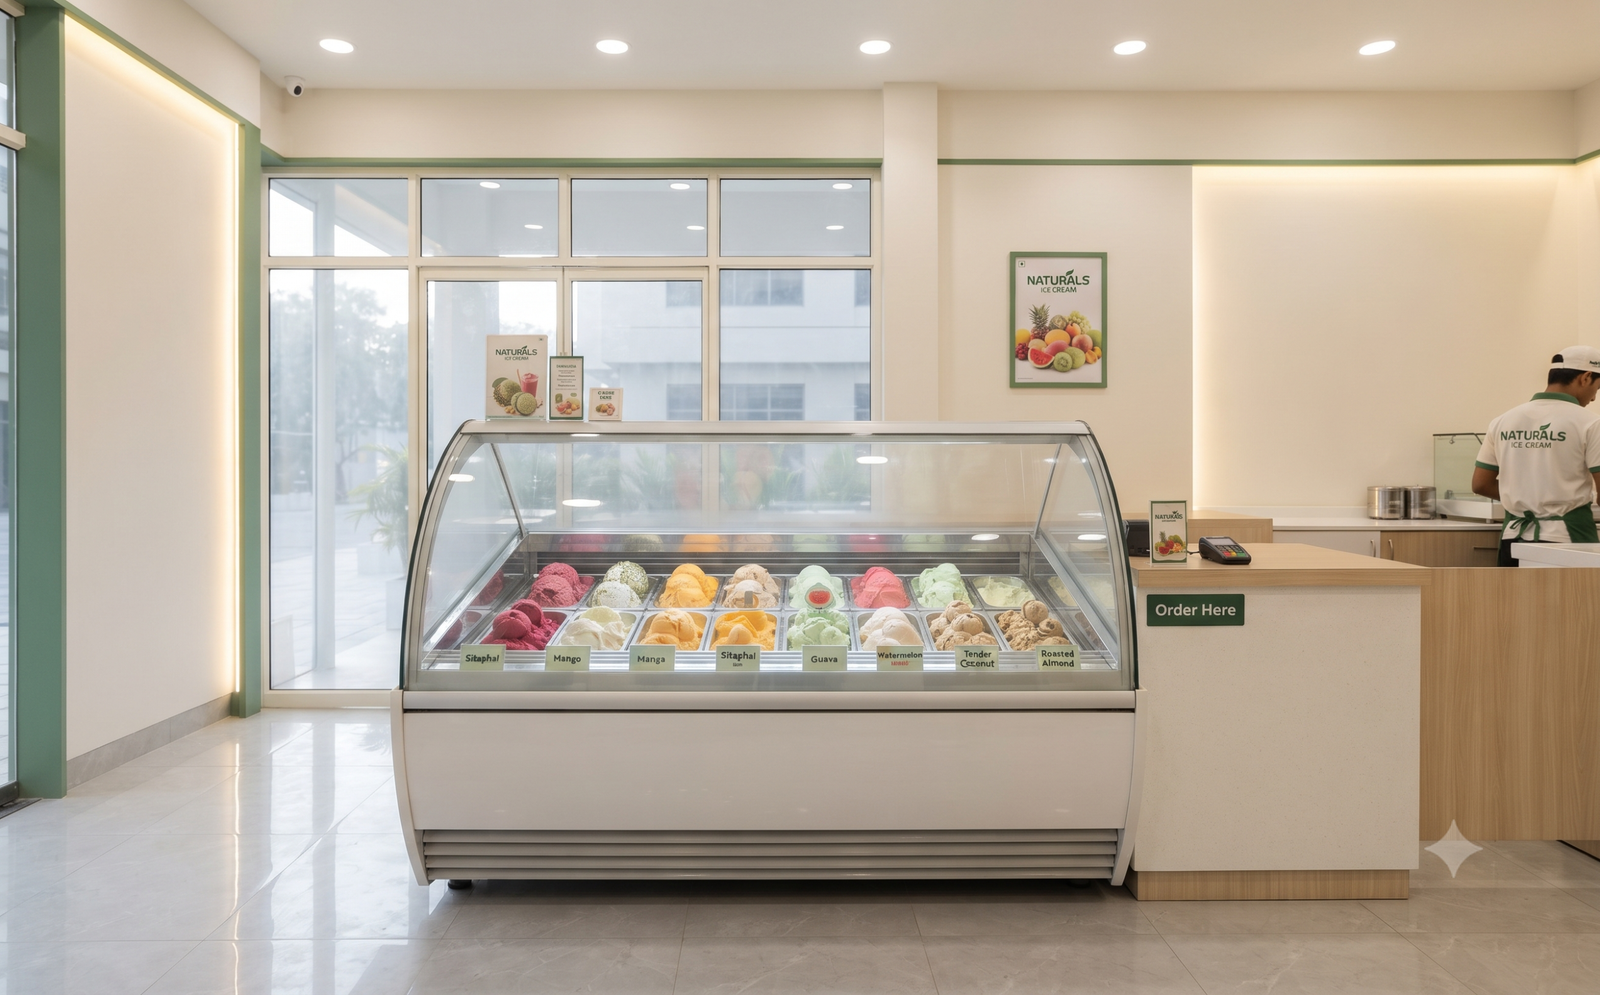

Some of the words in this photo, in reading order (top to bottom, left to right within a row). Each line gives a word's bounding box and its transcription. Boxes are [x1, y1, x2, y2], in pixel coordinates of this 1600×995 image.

[1027, 275, 1090, 286] NATURALS
[495, 348, 538, 356] NATURALS
[1500, 430, 1567, 442] NATURALS
[1511, 441, 1523, 449] ICE
[1525, 441, 1552, 449] CREAM
[1155, 603, 1198, 616] Order
[1201, 603, 1237, 616] Here
[465, 653, 500, 664] Sitaphal
[720, 651, 756, 661] Sitaphal
[877, 651, 923, 659] Watermelon
[963, 650, 992, 658] Tender
[1041, 650, 1075, 658] Roasted
[553, 654, 582, 665] Mango
[637, 655, 666, 665] Manga
[810, 655, 838, 664] Guava
[1041, 659, 1075, 667] Almond
